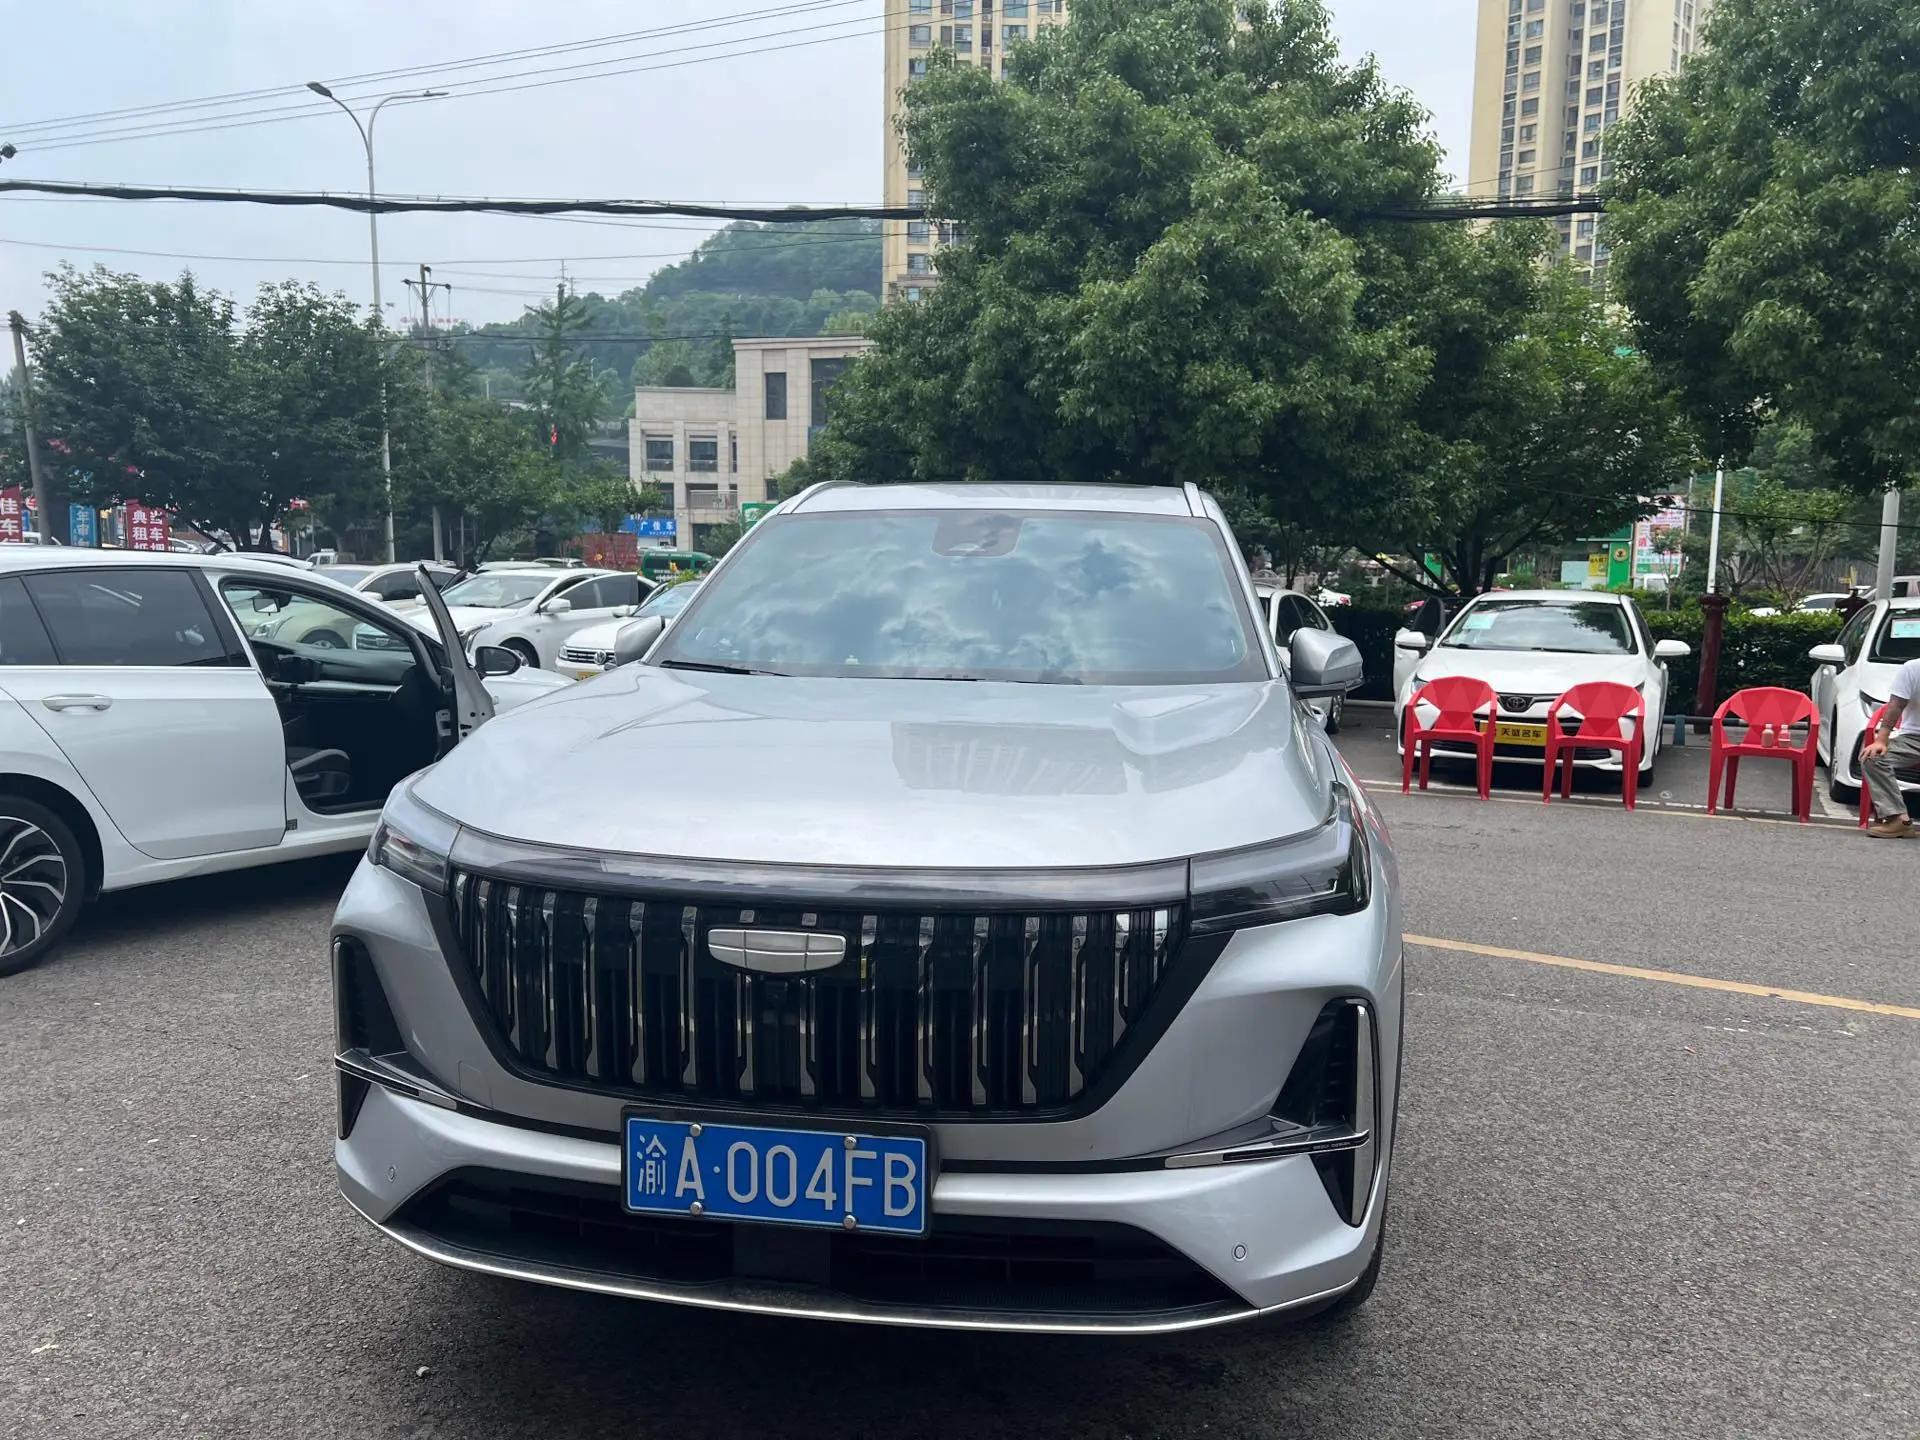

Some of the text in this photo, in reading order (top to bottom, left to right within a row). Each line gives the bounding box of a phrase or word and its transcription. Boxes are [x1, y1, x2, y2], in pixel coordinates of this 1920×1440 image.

[132, 510, 164, 525] 典当
[132, 527, 164, 541] 租车
[637, 1134, 917, 1217] 渝A·004FB
